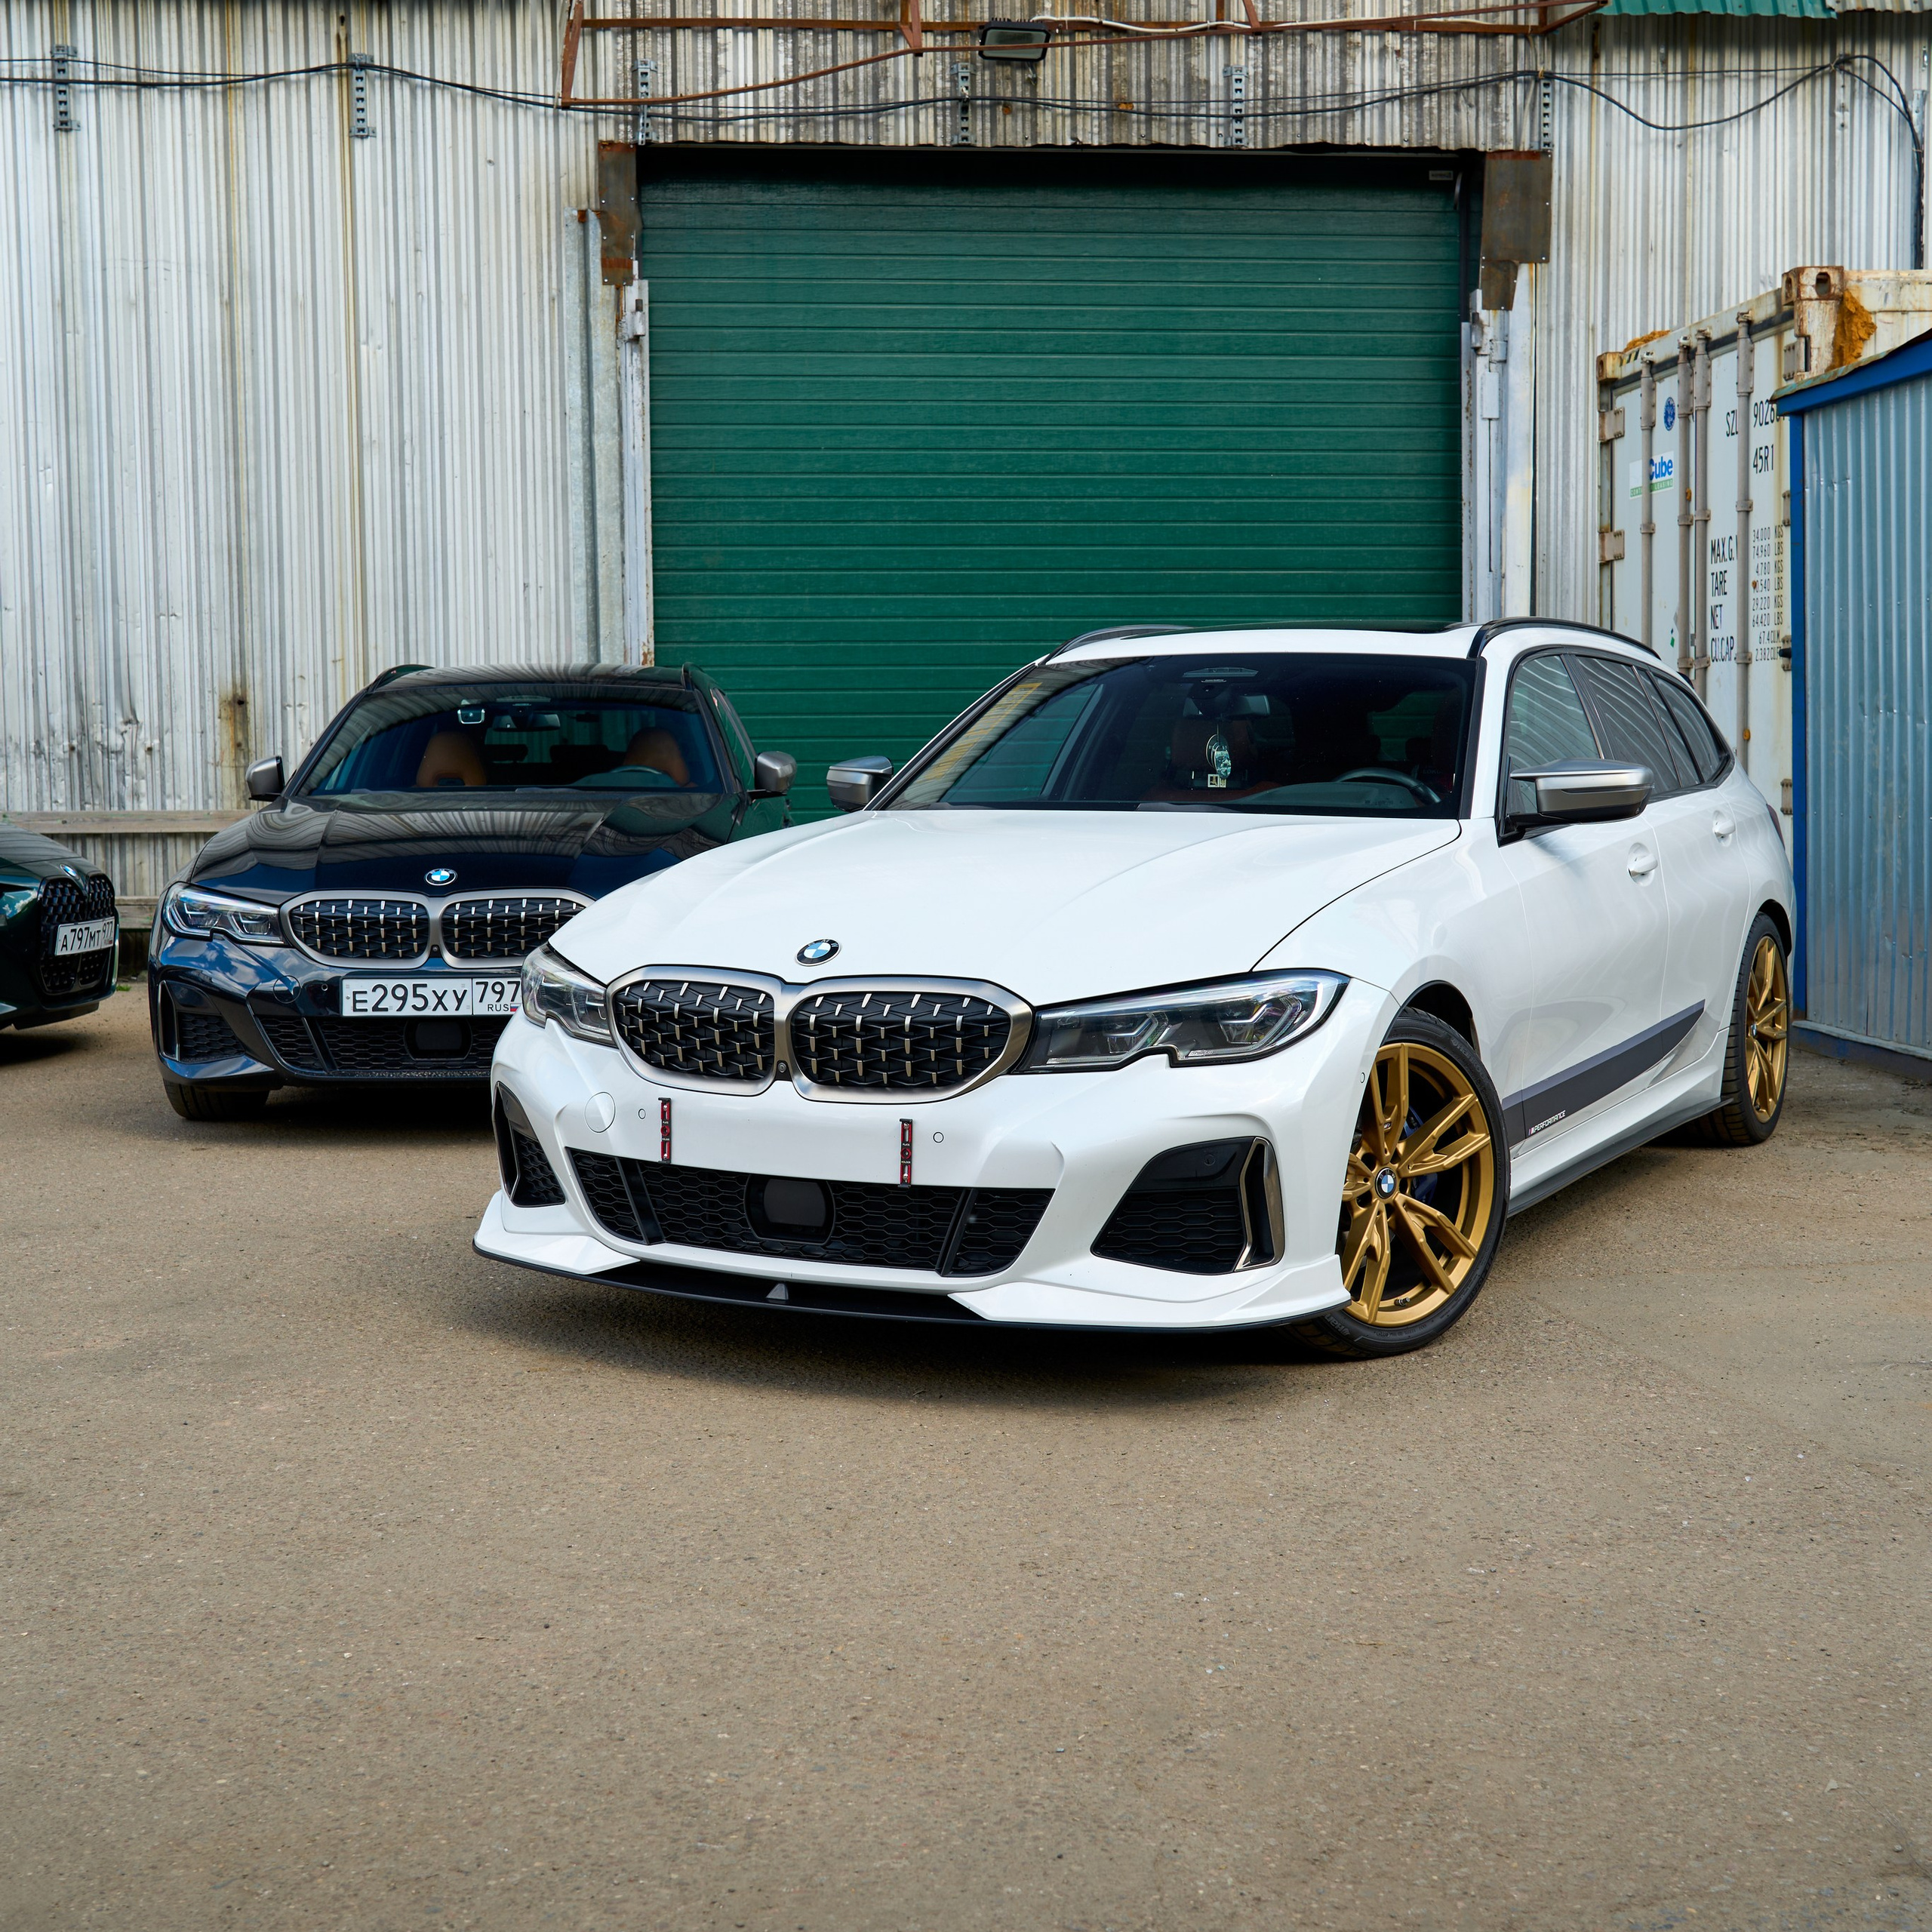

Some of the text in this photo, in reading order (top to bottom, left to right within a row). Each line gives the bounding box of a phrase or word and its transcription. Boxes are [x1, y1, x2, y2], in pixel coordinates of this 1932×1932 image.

[1753, 399, 1786, 428] 9026
[1753, 444, 1774, 474] 45R1
[1711, 570, 1727, 597] TARE
[1711, 604, 1723, 630] NET
[103, 921, 113, 939] 977
[475, 981, 521, 1003] 797
[487, 1004, 509, 1012] RUS
